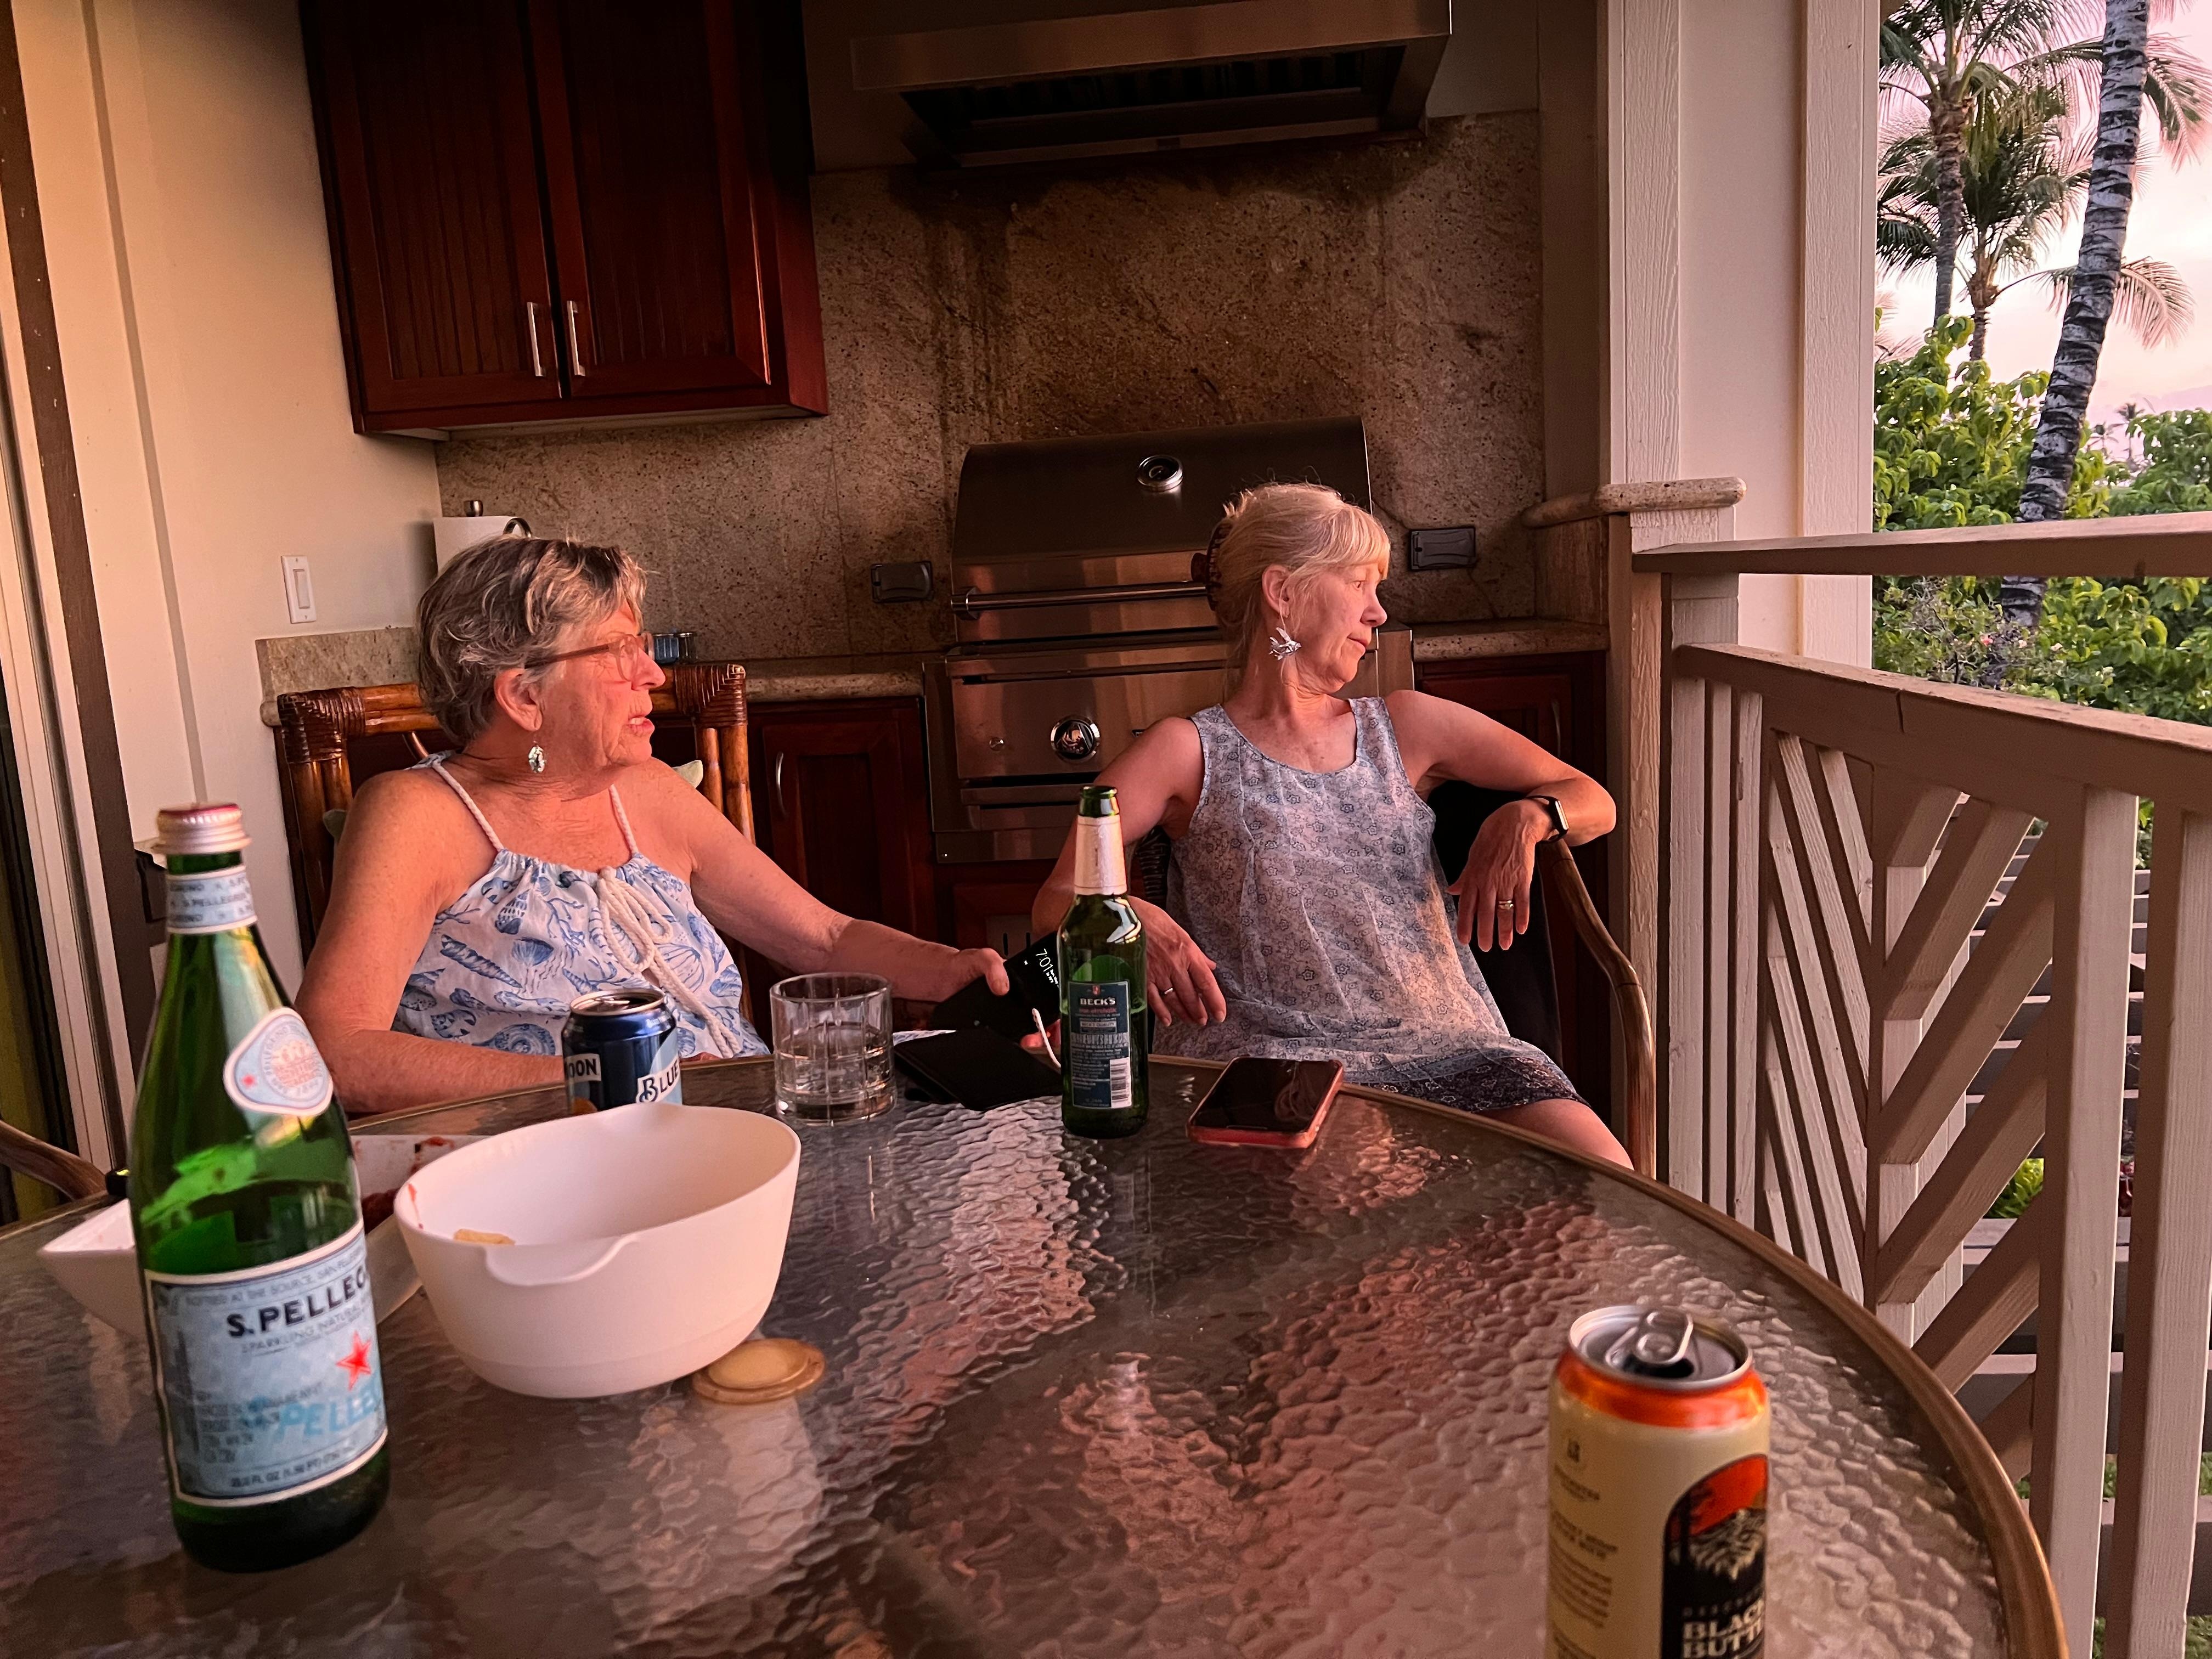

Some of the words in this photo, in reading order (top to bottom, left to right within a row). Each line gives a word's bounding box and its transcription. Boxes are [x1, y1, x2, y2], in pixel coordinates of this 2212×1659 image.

[1035, 948, 1053, 972] 7:01
[1080, 997, 1116, 1006] BECK'S
[639, 1059, 678, 1103] BLUE
